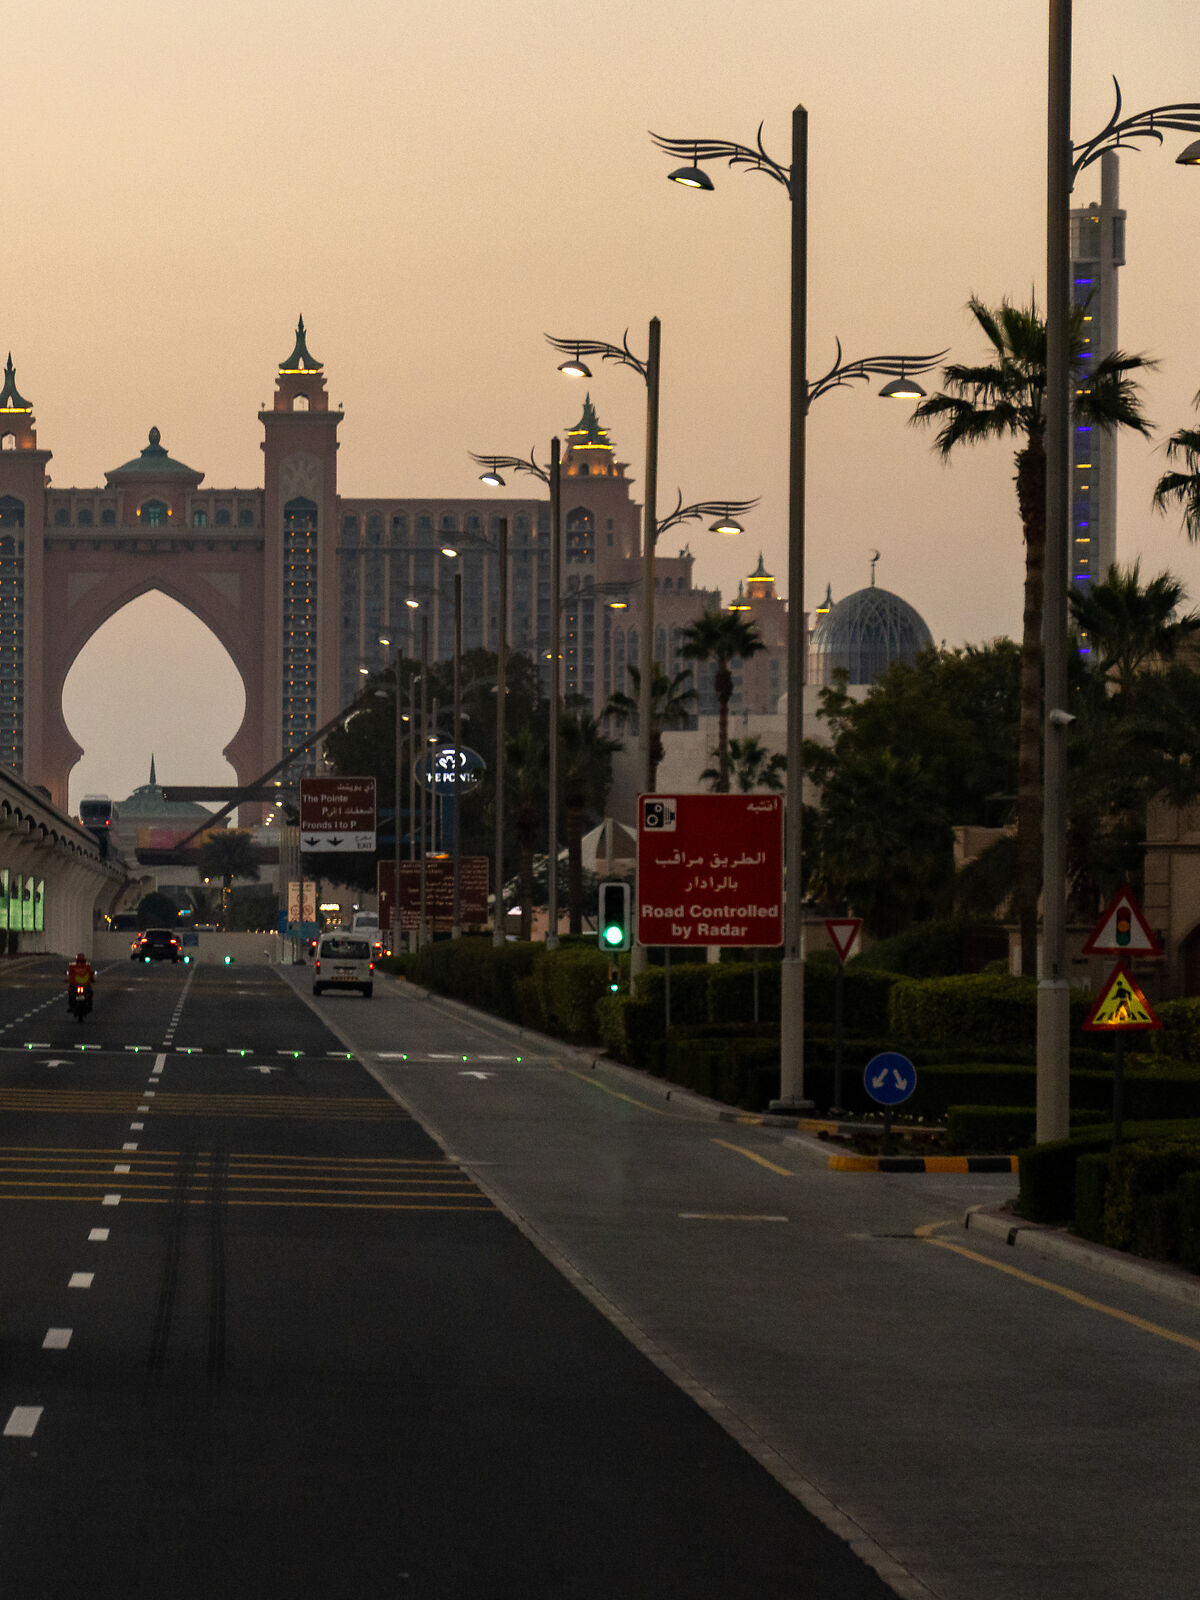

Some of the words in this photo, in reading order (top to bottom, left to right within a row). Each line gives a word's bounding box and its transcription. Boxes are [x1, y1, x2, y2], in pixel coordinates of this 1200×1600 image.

[303, 794, 319, 803] The
[320, 793, 349, 803] Pointe
[302, 820, 332, 829] Fronds
[340, 821, 349, 829] to
[350, 820, 357, 829] P
[655, 849, 704, 868] مراقب
[709, 852, 766, 868] الطريق
[685, 876, 738, 892] بالرادار
[641, 904, 685, 918] Road
[689, 904, 779, 918] Controlled
[671, 923, 692, 940] by
[697, 923, 748, 937] Radar
